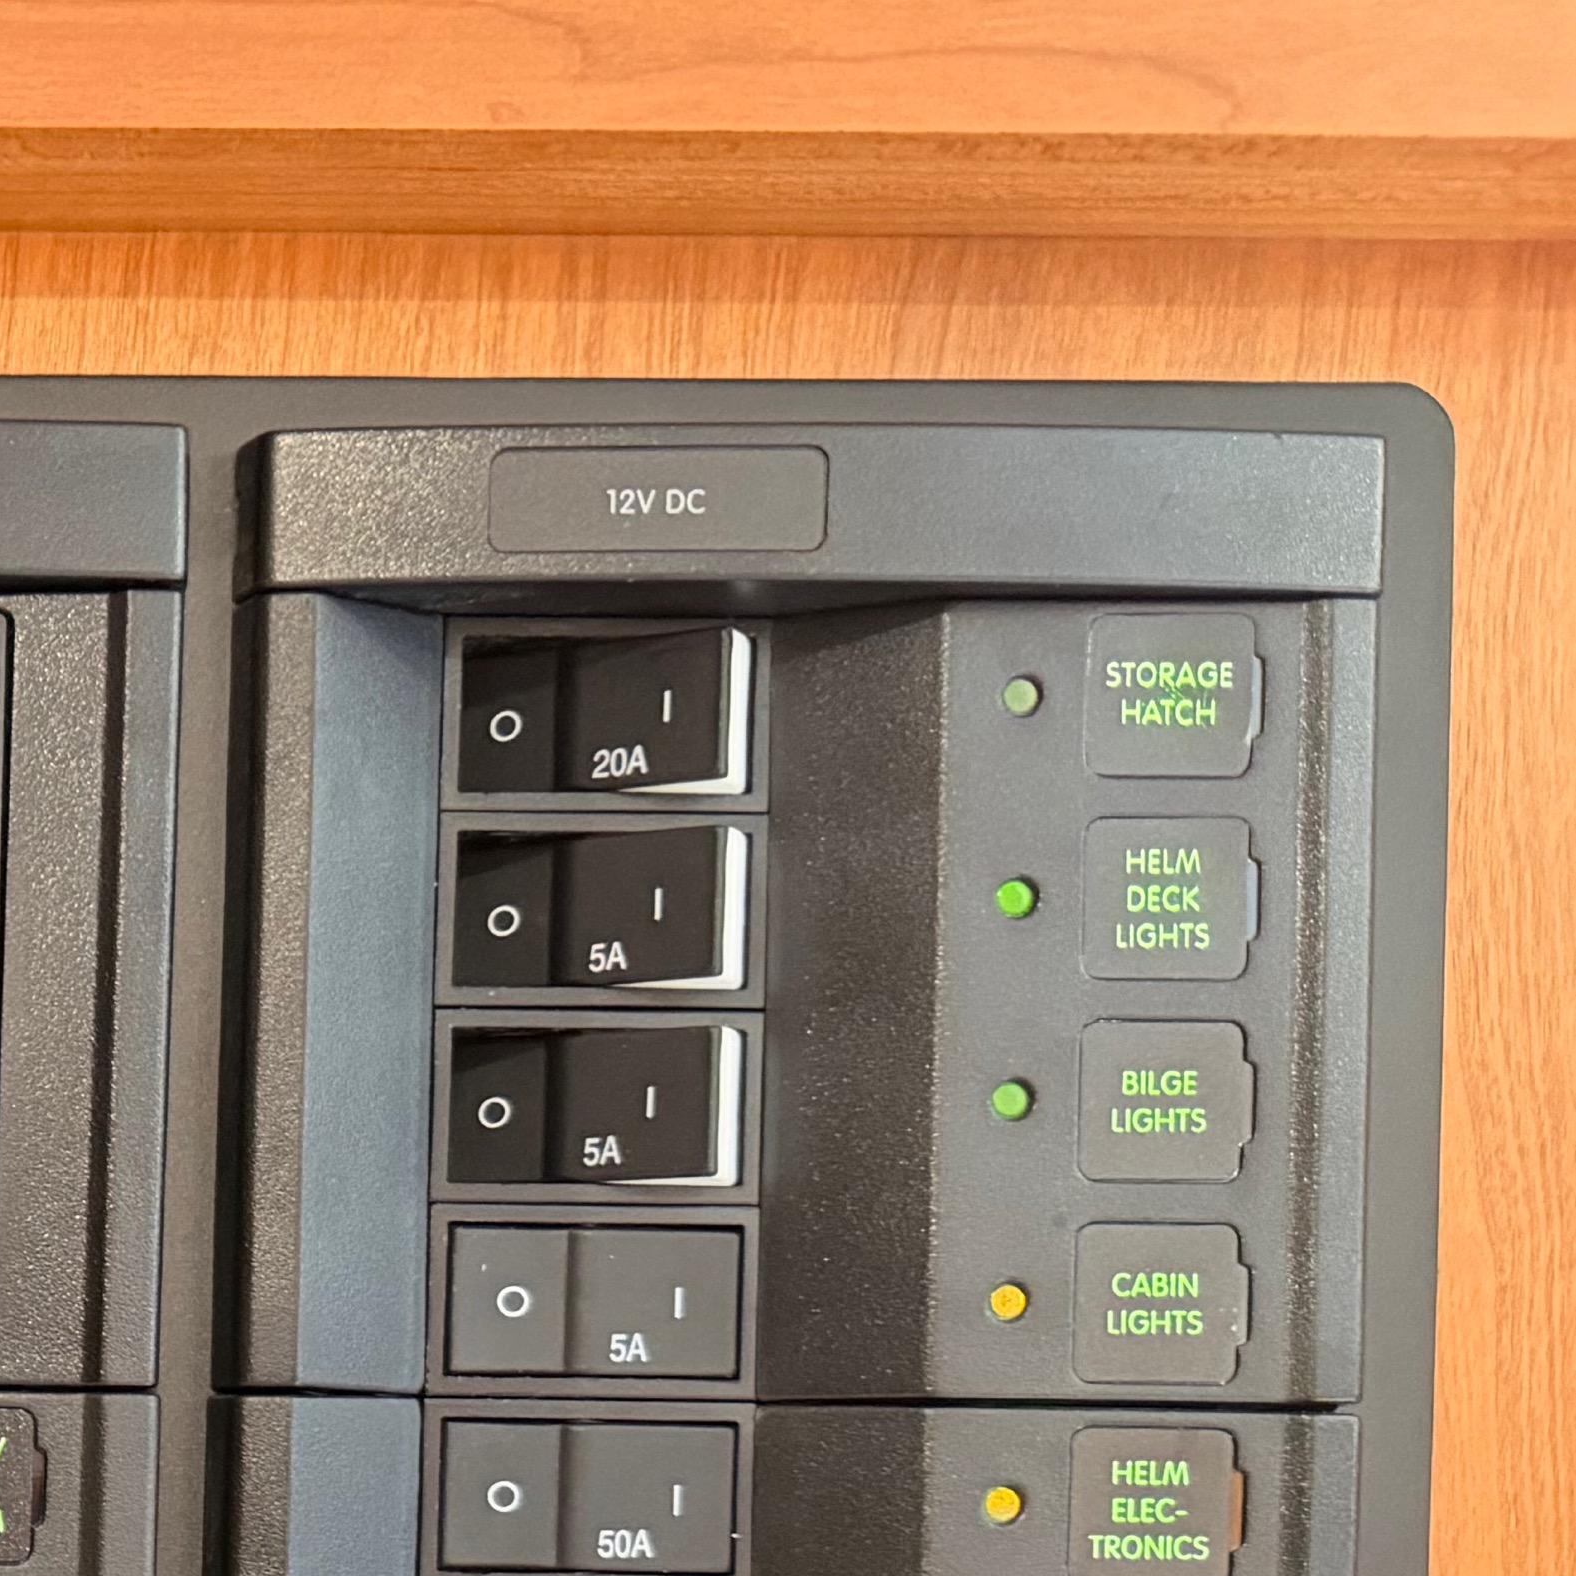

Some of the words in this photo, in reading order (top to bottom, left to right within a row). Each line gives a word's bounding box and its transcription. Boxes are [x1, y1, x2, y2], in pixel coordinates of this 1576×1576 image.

[607, 489, 655, 514] 12V
[666, 489, 705, 513] DC
[1106, 661, 1233, 692] STORAGE
[1122, 699, 1215, 727] HATCH
[592, 745, 648, 778] 20A
[1126, 848, 1201, 874] HELM
[1127, 885, 1200, 912] DECK
[1117, 923, 1210, 949] LIGHTS
[589, 942, 626, 972] 5A
[1122, 1070, 1197, 1095] BILGE
[1112, 1108, 1207, 1133] LIGHTS
[583, 1135, 621, 1166] 5A
[1112, 1273, 1198, 1297] CABIN
[1108, 1310, 1203, 1335] LIGHTS
[610, 1333, 648, 1362] 5A
[1112, 1460, 1189, 1486] HELM
[1112, 1498, 1188, 1523] ELEC-
[598, 1529, 654, 1558] 50A
[1088, 1535, 1209, 1560] TRONICS
